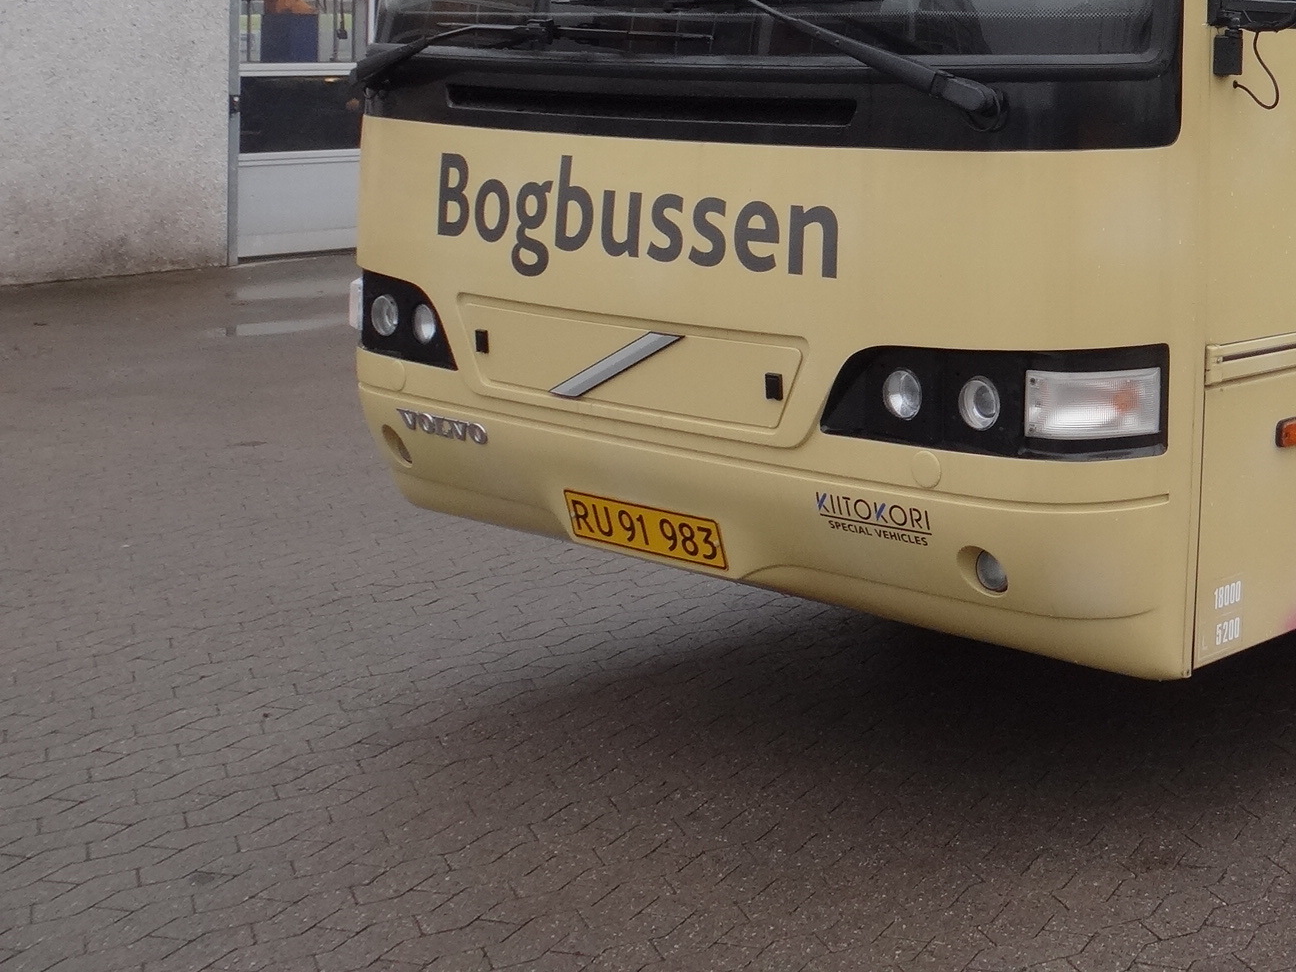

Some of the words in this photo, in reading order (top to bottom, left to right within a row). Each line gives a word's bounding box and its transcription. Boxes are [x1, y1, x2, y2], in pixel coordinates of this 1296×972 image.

[436, 152, 840, 279] Bogbussen
[396, 408, 488, 444] VOLVO
[816, 491, 931, 531] KIITOKORI
[570, 499, 614, 537] RU
[618, 509, 650, 546] 91
[658, 518, 718, 560] 983
[828, 519, 873, 537] SPECIAL
[874, 528, 929, 547] VEHICLES
[1213, 580, 1242, 610] 18000
[1215, 616, 1240, 646] 5200
